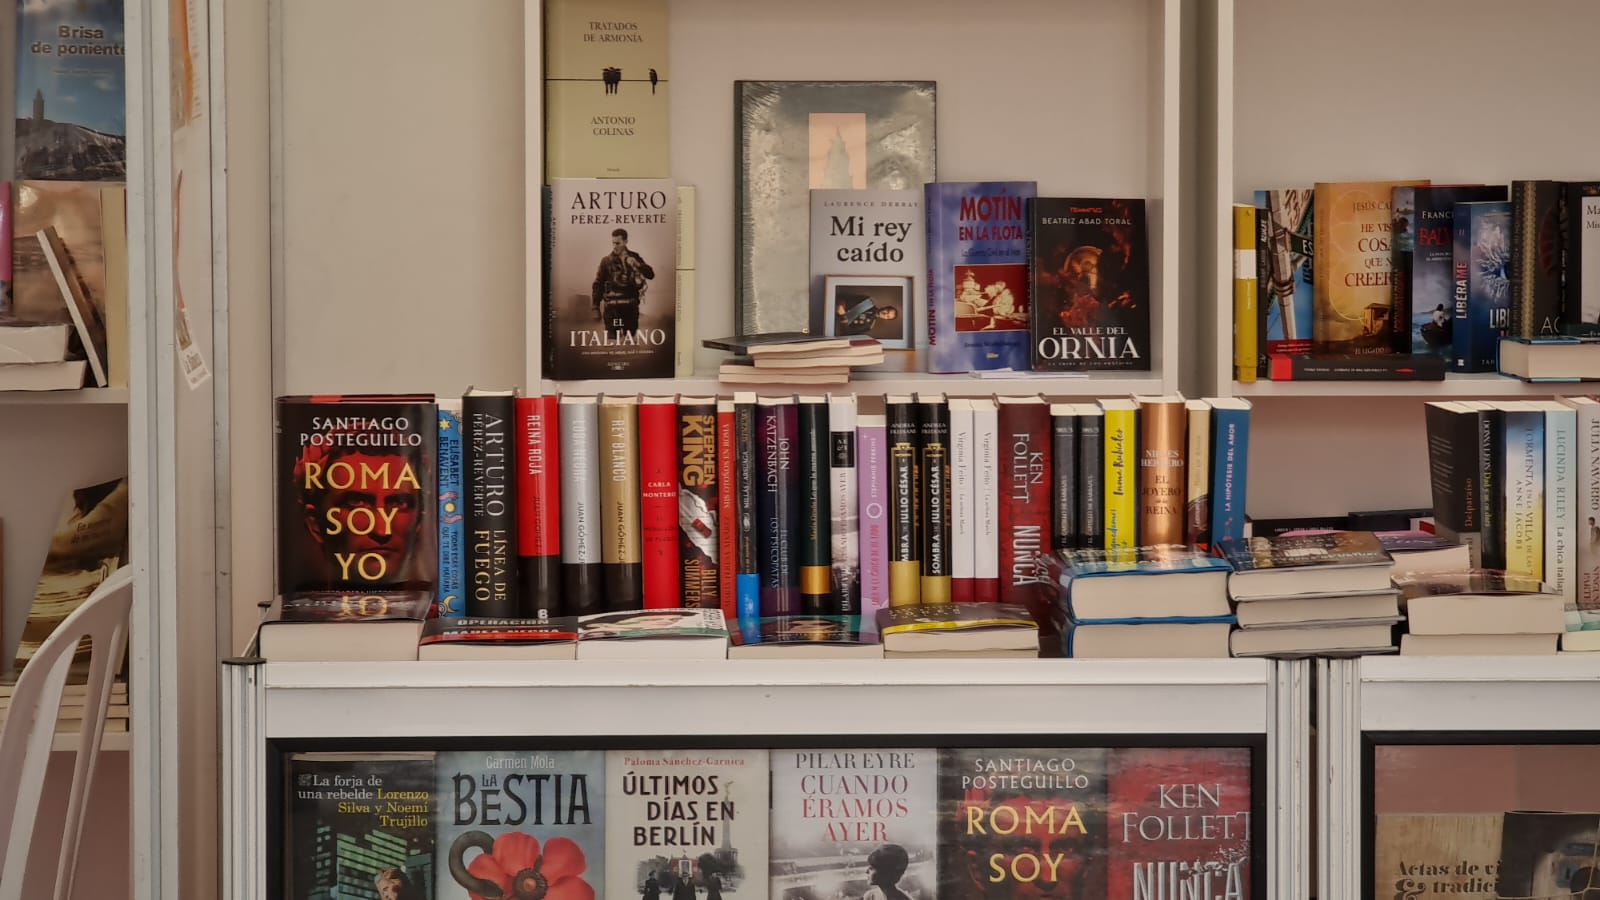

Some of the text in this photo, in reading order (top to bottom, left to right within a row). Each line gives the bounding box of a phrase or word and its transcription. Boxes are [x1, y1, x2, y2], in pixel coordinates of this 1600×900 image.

[58, 25, 104, 39] Brisa
[583, 32, 644, 43] DE ARMONÍA
[589, 21, 638, 32] TRATADOS
[31, 41, 52, 54] de
[590, 116, 636, 126] ANTONIO
[592, 127, 635, 137] COLINAS
[571, 191, 667, 211] ARTURO
[823, 200, 875, 208] LAURENCE
[959, 189, 1022, 222] MOTÍN
[571, 212, 667, 225] PÉREZ-REVERTE
[830, 215, 913, 243] Mi rey
[1361, 223, 1392, 233] HE VIS
[959, 226, 1023, 241] EN LA FLOTA
[836, 242, 904, 263] caído
[1365, 257, 1382, 268] QUE
[1455, 262, 1467, 319] LIBÉRAME
[612, 317, 625, 328] EL
[1053, 327, 1128, 336] EL VALLE DEL
[569, 329, 667, 347] ITALIANO
[1039, 337, 1140, 360] ORNIA
[312, 416, 409, 431] SANTIAGO
[722, 423, 730, 447] ROMA
[300, 433, 422, 447] POSTEGUILLO
[527, 414, 543, 475] REINA ROJA
[611, 419, 626, 482] REY BLANCO
[682, 415, 704, 487] KING
[702, 415, 716, 485] STEPHEN
[958, 431, 966, 463] Virginia
[1112, 428, 1124, 467] Rubiales
[439, 436, 449, 488] BENAVENT
[450, 439, 460, 486] ELISABET
[485, 413, 505, 517] ARTURO
[767, 415, 777, 493] KATZENBACH
[779, 438, 790, 470] JOHN
[983, 431, 992, 486] Virginia Feito
[1590, 418, 1600, 510] JULIA NAVARRO
[304, 462, 422, 490] ROMA
[1012, 433, 1030, 504] FOLLETT
[1030, 451, 1043, 484] KEN
[1155, 476, 1169, 484] EL
[1113, 470, 1124, 496] Inma
[1142, 488, 1181, 496] JOYERO
[1515, 479, 1523, 508] ANNE
[577, 502, 585, 523] JUAN
[898, 465, 909, 562] MBRA JULIO CÉSAR
[929, 465, 941, 575] SOMBRA JULIO CÉSAR
[1146, 506, 1177, 515] REINA
[1224, 503, 1231, 512] LA
[1556, 430, 1566, 594] LUCINDA RILEY La chica italian
[326, 507, 399, 536] SOY
[1525, 511, 1534, 542] VILLA
[334, 553, 387, 581] YO
[474, 529, 491, 601] FUEGO
[493, 529, 507, 601] LÍNEA DE
[1012, 525, 1042, 587] NUNCA
[684, 559, 700, 609] SUMMERS
[701, 565, 717, 598] BILLY
[486, 755, 555, 770] Carmen Mola
[624, 756, 745, 767] Paloma Sánchez-Garnica
[796, 753, 915, 769] PILAR EYRE
[975, 758, 1076, 772] SANTIAGO
[313, 775, 383, 789] La forja de
[481, 774, 498, 787] LA
[622, 771, 719, 796] ÚLTIMOS
[801, 774, 909, 795] CUANDO
[961, 775, 1089, 790] POSTEGUILLO
[298, 788, 429, 800] una rebelde Lorenzo
[452, 772, 593, 826] BESTIA
[802, 793, 909, 819] ÉRAMOS
[1158, 783, 1222, 809] KEN
[338, 802, 429, 815] Silva y Noemí
[646, 797, 735, 821] DÍAS EN
[966, 805, 1088, 835] ROMA
[380, 815, 428, 830] Trujillo
[633, 821, 715, 846] BERLÍN
[823, 821, 889, 842] AYER
[988, 853, 1065, 883] SOY
[1133, 861, 1245, 900] NUNCA
[1399, 860, 1479, 876] Actas de
